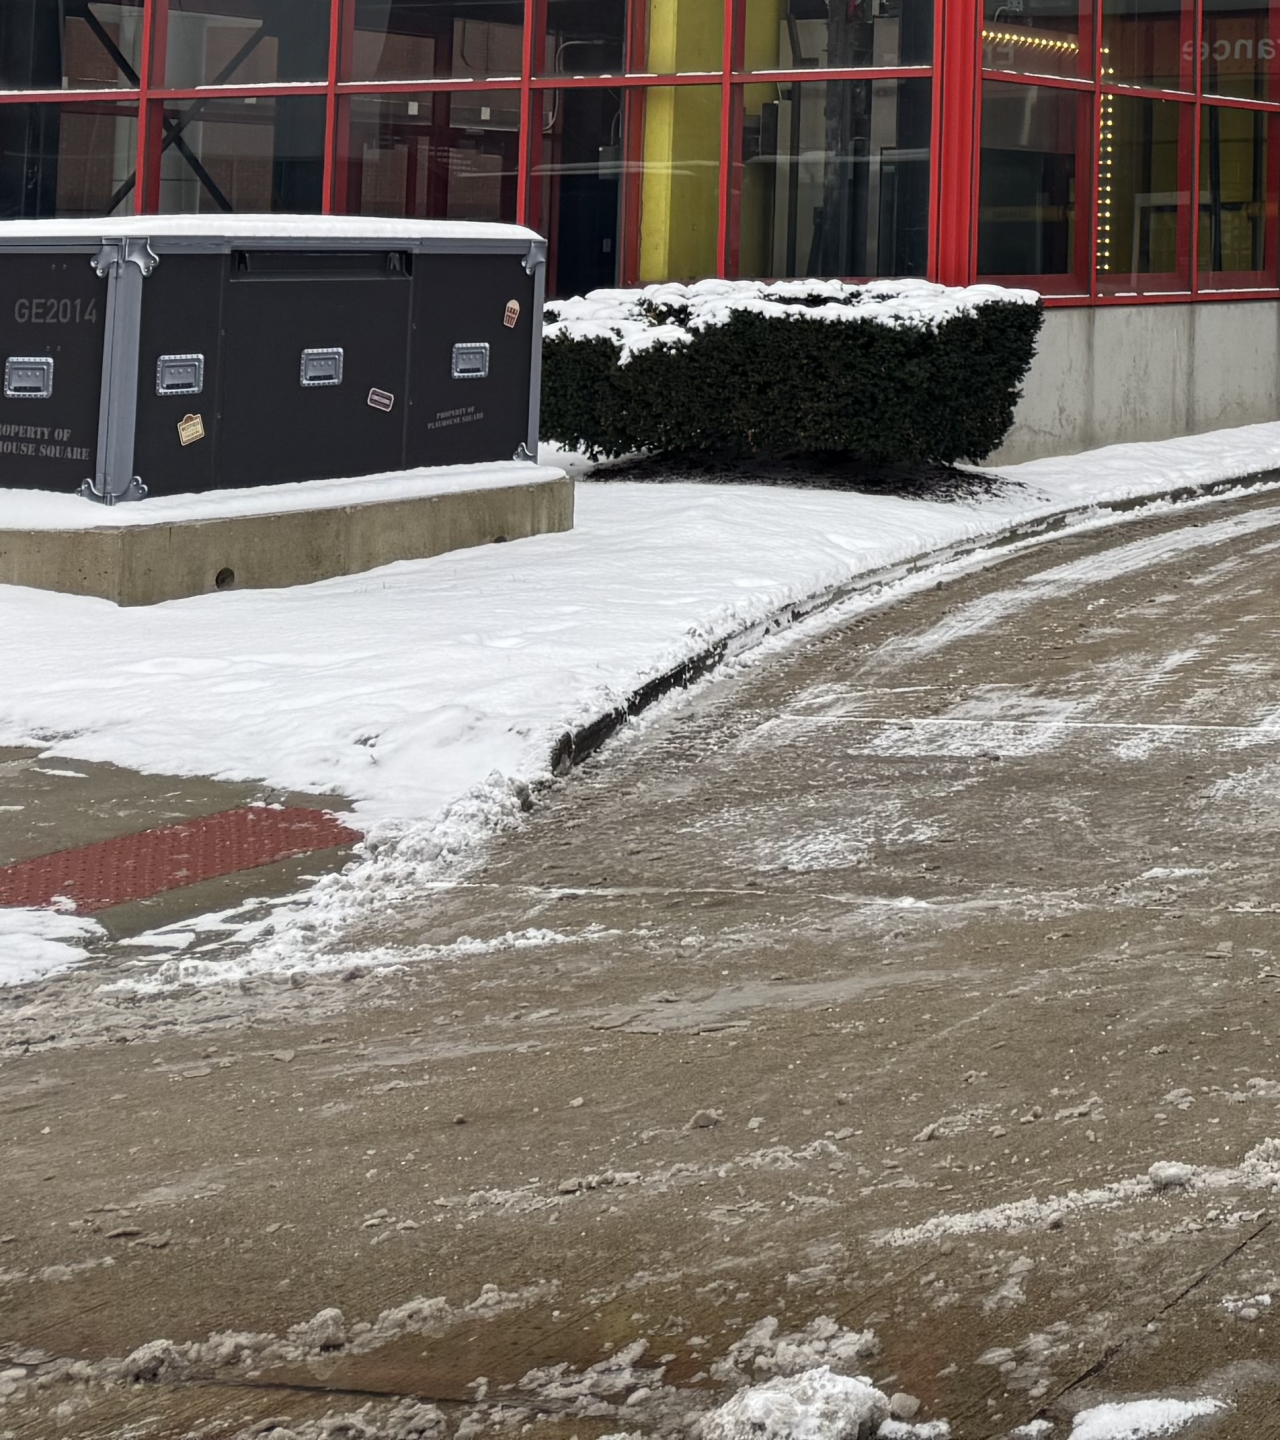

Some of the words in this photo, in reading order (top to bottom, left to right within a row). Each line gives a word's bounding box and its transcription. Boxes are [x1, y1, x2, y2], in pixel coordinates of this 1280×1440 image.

[14, 298, 97, 323] GE2014
[0, 423, 51, 440] OPERTY
[54, 428, 72, 441] OF
[39, 444, 90, 460] SQUARE
